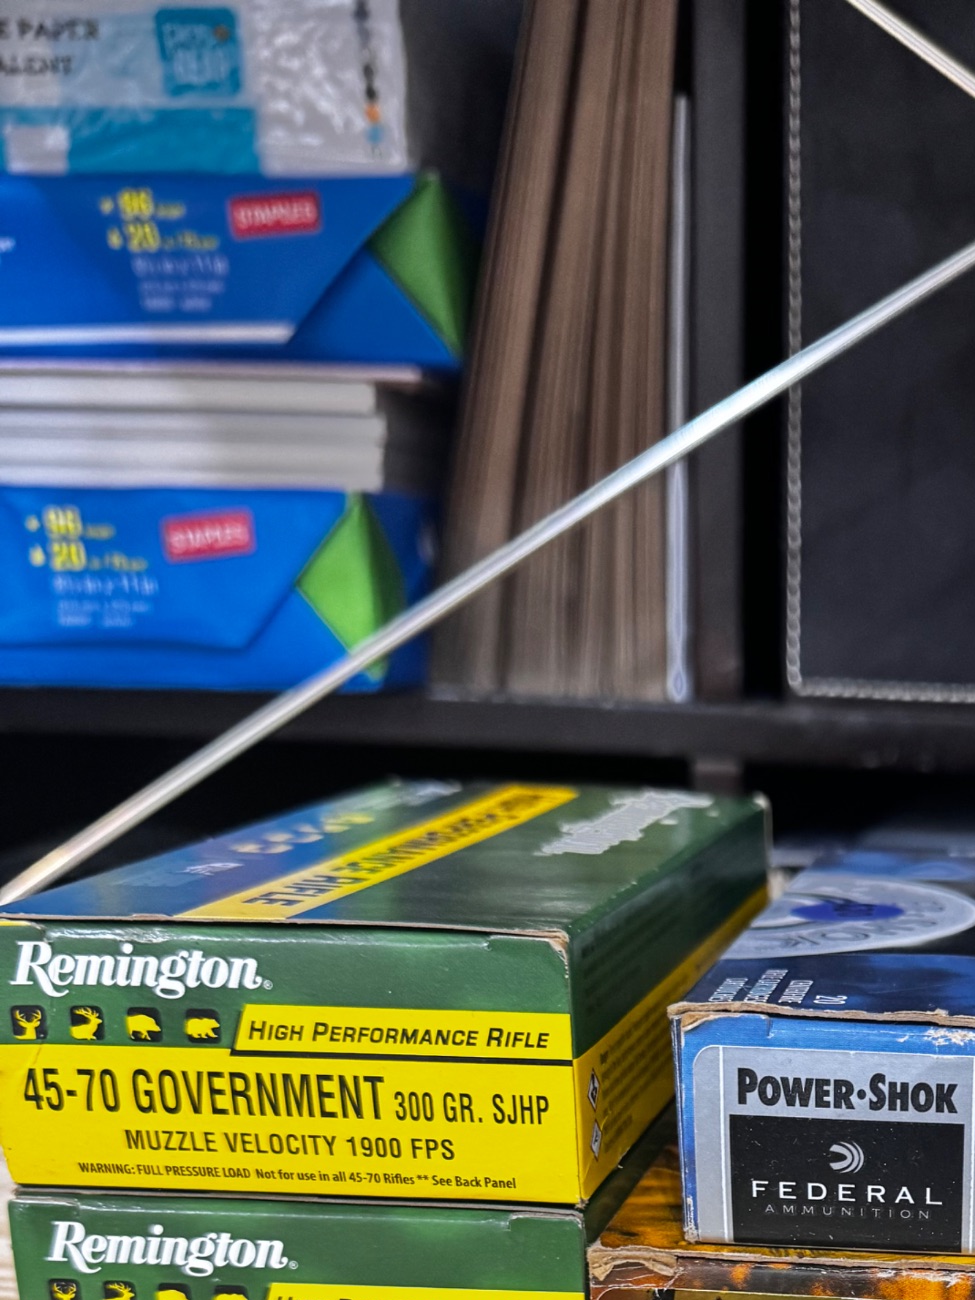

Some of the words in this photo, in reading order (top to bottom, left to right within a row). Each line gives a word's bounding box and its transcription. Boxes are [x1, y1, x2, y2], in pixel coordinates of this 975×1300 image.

[248, 1021, 304, 1042] HIGH
[312, 1022, 479, 1046] PERFORMANCE
[486, 1028, 550, 1048] RIFLE
[24, 1068, 121, 1112] 45-70
[132, 1068, 385, 1120] GOVERNMENT
[394, 1091, 435, 1122] 300
[443, 1092, 484, 1123] GR.
[493, 1094, 550, 1125] SJHP
[124, 1129, 218, 1152] MUZZLE
[224, 1132, 336, 1156] VELOCITY
[346, 1136, 402, 1158] 1900
[411, 1138, 455, 1160] FPS
[78, 1162, 135, 1176] WARNING:
[137, 1164, 164, 1177] FULL
[165, 1165, 221, 1178] PRESSURE
[222, 1167, 251, 1179] LOAD
[256, 1168, 276, 1180] Not
[278, 1168, 294, 1181] for
[297, 1171, 317, 1182] use
[319, 1169, 330, 1182] in
[332, 1170, 347, 1182] all
[348, 1172, 381, 1184] 45-70
[383, 1173, 415, 1186] Rifles
[432, 1175, 453, 1187] See
[455, 1176, 482, 1188] Back
[484, 1177, 517, 1189] Panel
[752, 1180, 943, 1206] FEDERAL
[765, 1204, 931, 1220] AMMUNITION
